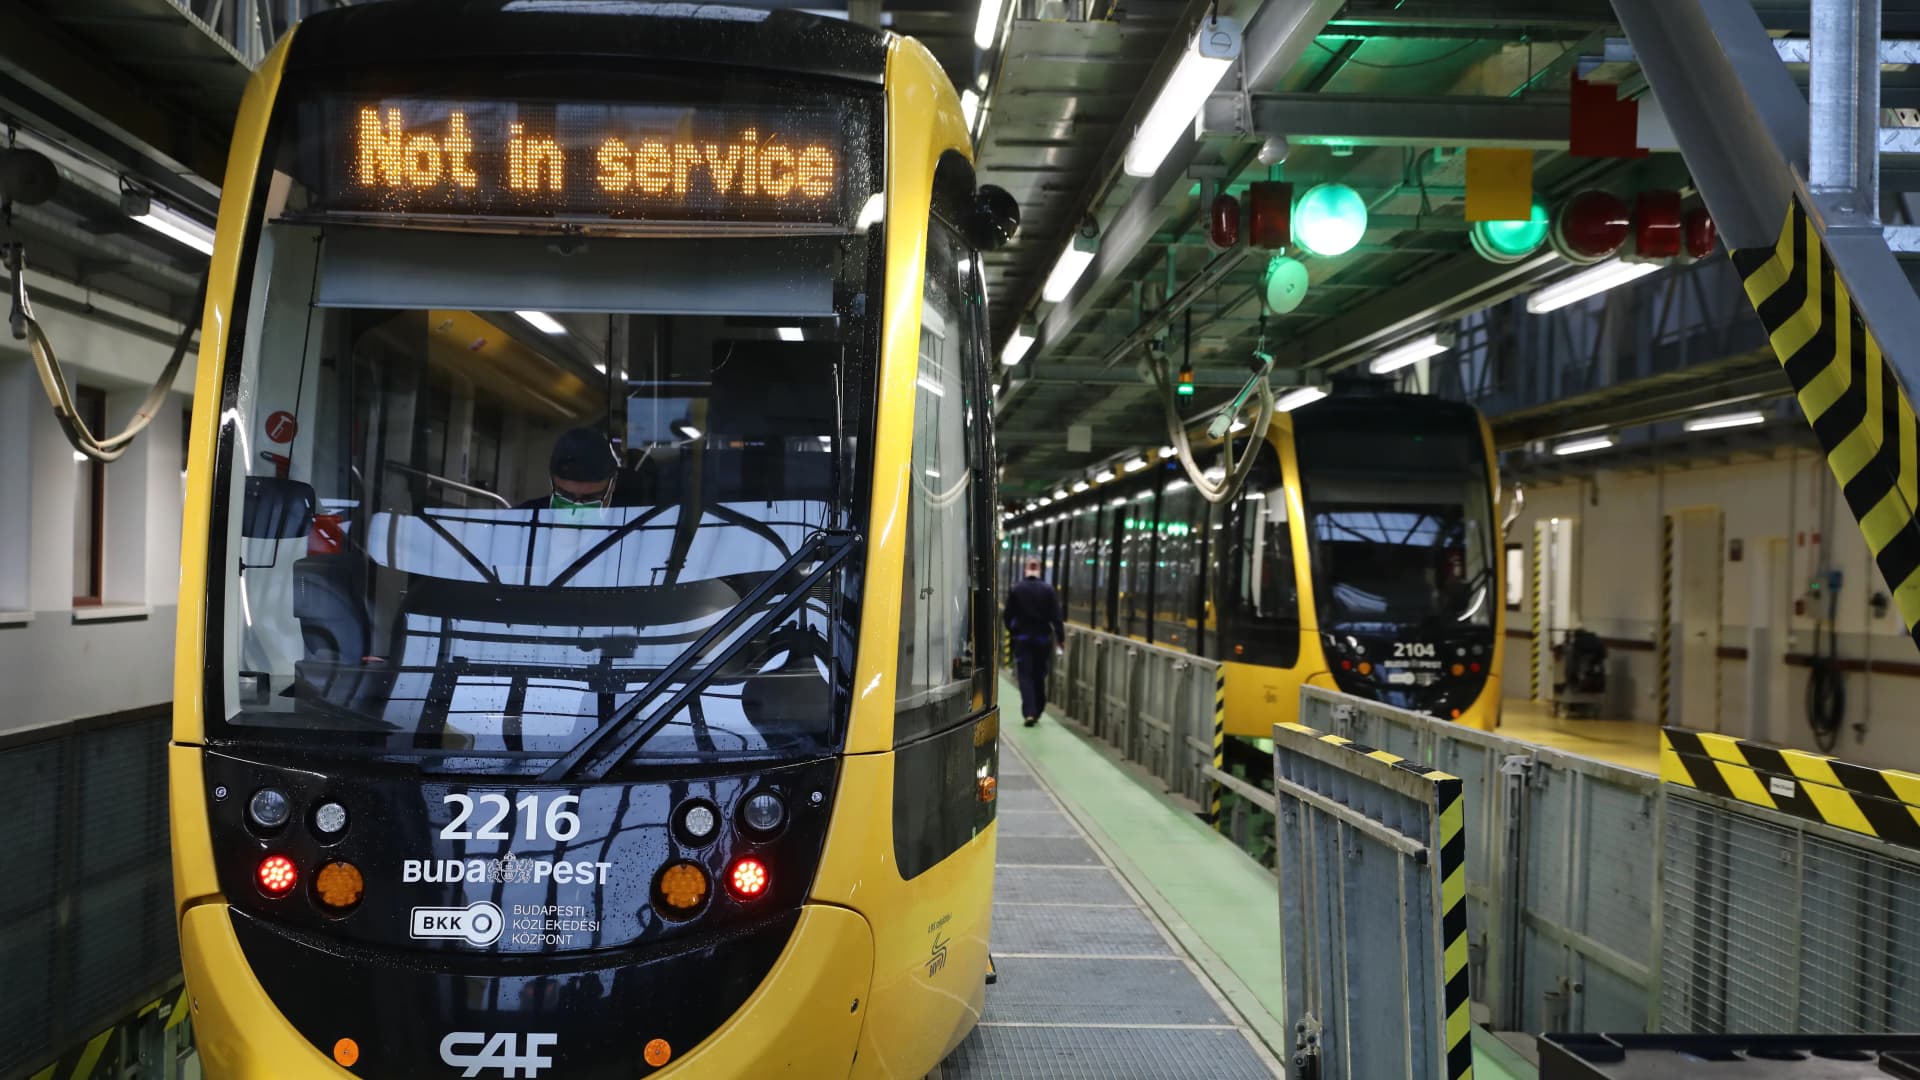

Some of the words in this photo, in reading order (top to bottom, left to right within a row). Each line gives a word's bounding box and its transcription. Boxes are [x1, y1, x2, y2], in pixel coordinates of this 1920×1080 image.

[359, 108, 477, 188] Not
[509, 123, 565, 191] in
[596, 127, 836, 198] service
[1393, 642, 1436, 657] 2104
[439, 793, 581, 842] 2216
[513, 904, 586, 918] BUDAPESTI
[423, 916, 462, 930] BKK
[512, 917, 600, 932] KÖZLEKEDÉSI
[511, 932, 574, 945] KÖZPONT
[439, 1031, 558, 1079] CAF
